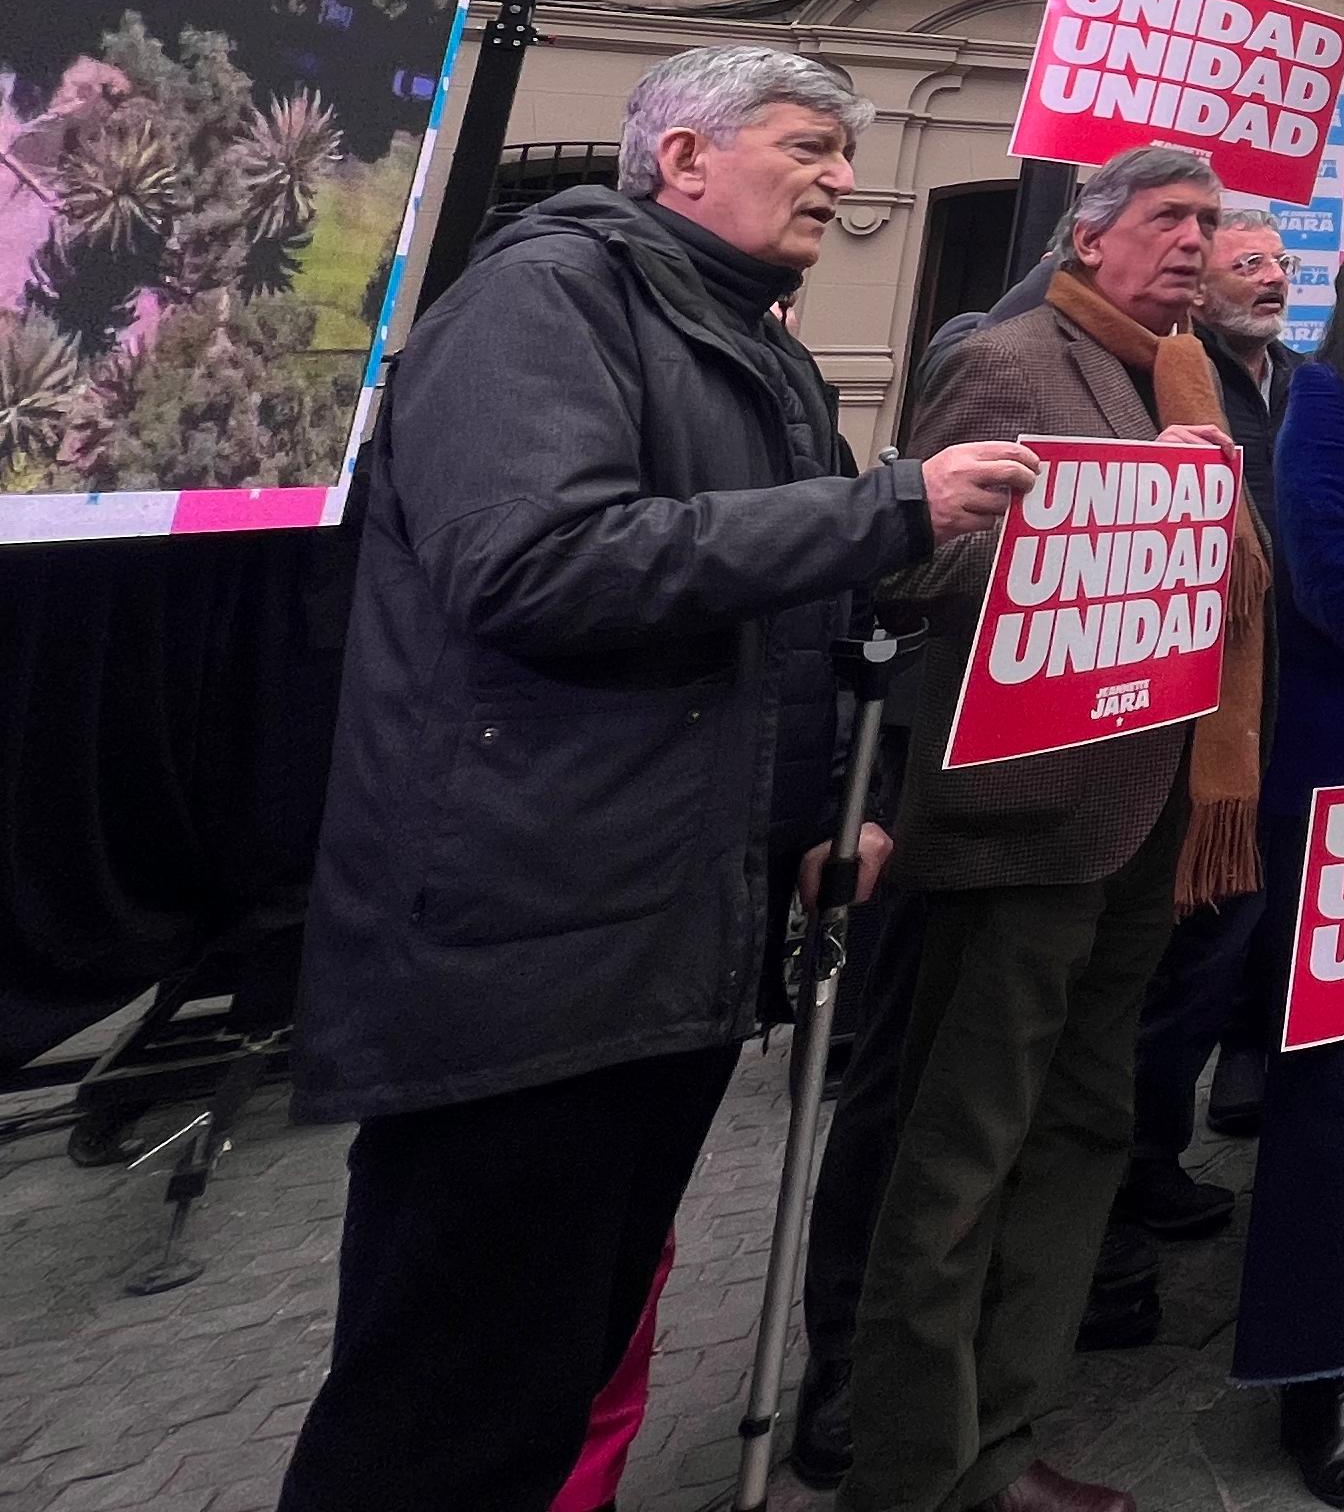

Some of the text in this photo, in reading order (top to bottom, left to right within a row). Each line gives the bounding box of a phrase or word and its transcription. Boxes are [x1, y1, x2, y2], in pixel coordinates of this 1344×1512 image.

[1053, 16, 1330, 112] UNIDAD
[1040, 65, 1318, 157] UNIDAD
[1022, 461, 1235, 530] UNIDAD
[1007, 526, 1228, 606] UNIDAD
[988, 590, 1222, 685] UNIDAD
[1090, 689, 1149, 720] JARA
